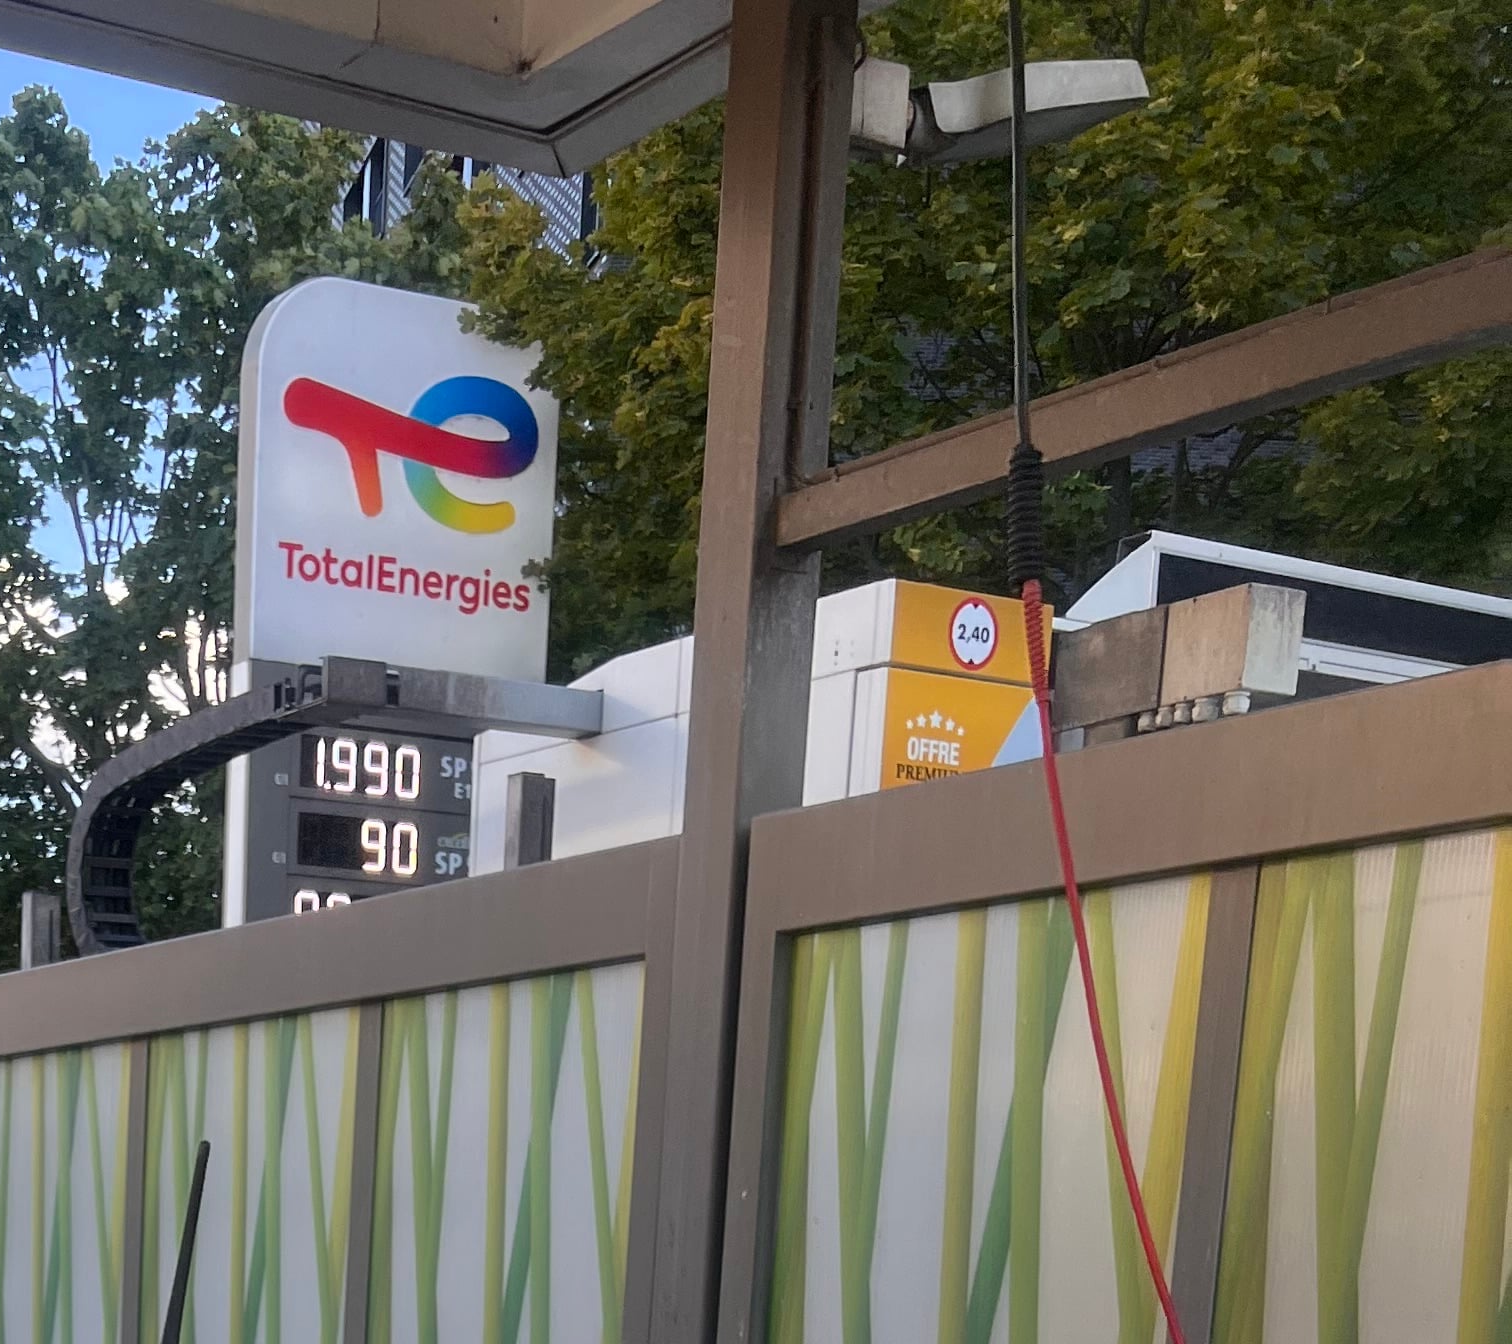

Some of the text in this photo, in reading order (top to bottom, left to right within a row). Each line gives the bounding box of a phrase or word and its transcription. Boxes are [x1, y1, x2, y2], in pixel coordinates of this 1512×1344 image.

[277, 540, 531, 615] TotalEnergies
[957, 623, 991, 644] 2,40
[315, 736, 421, 800] 1.990
[906, 735, 961, 767] OFFRE
[453, 782, 472, 799] E1
[360, 818, 419, 876] 90
